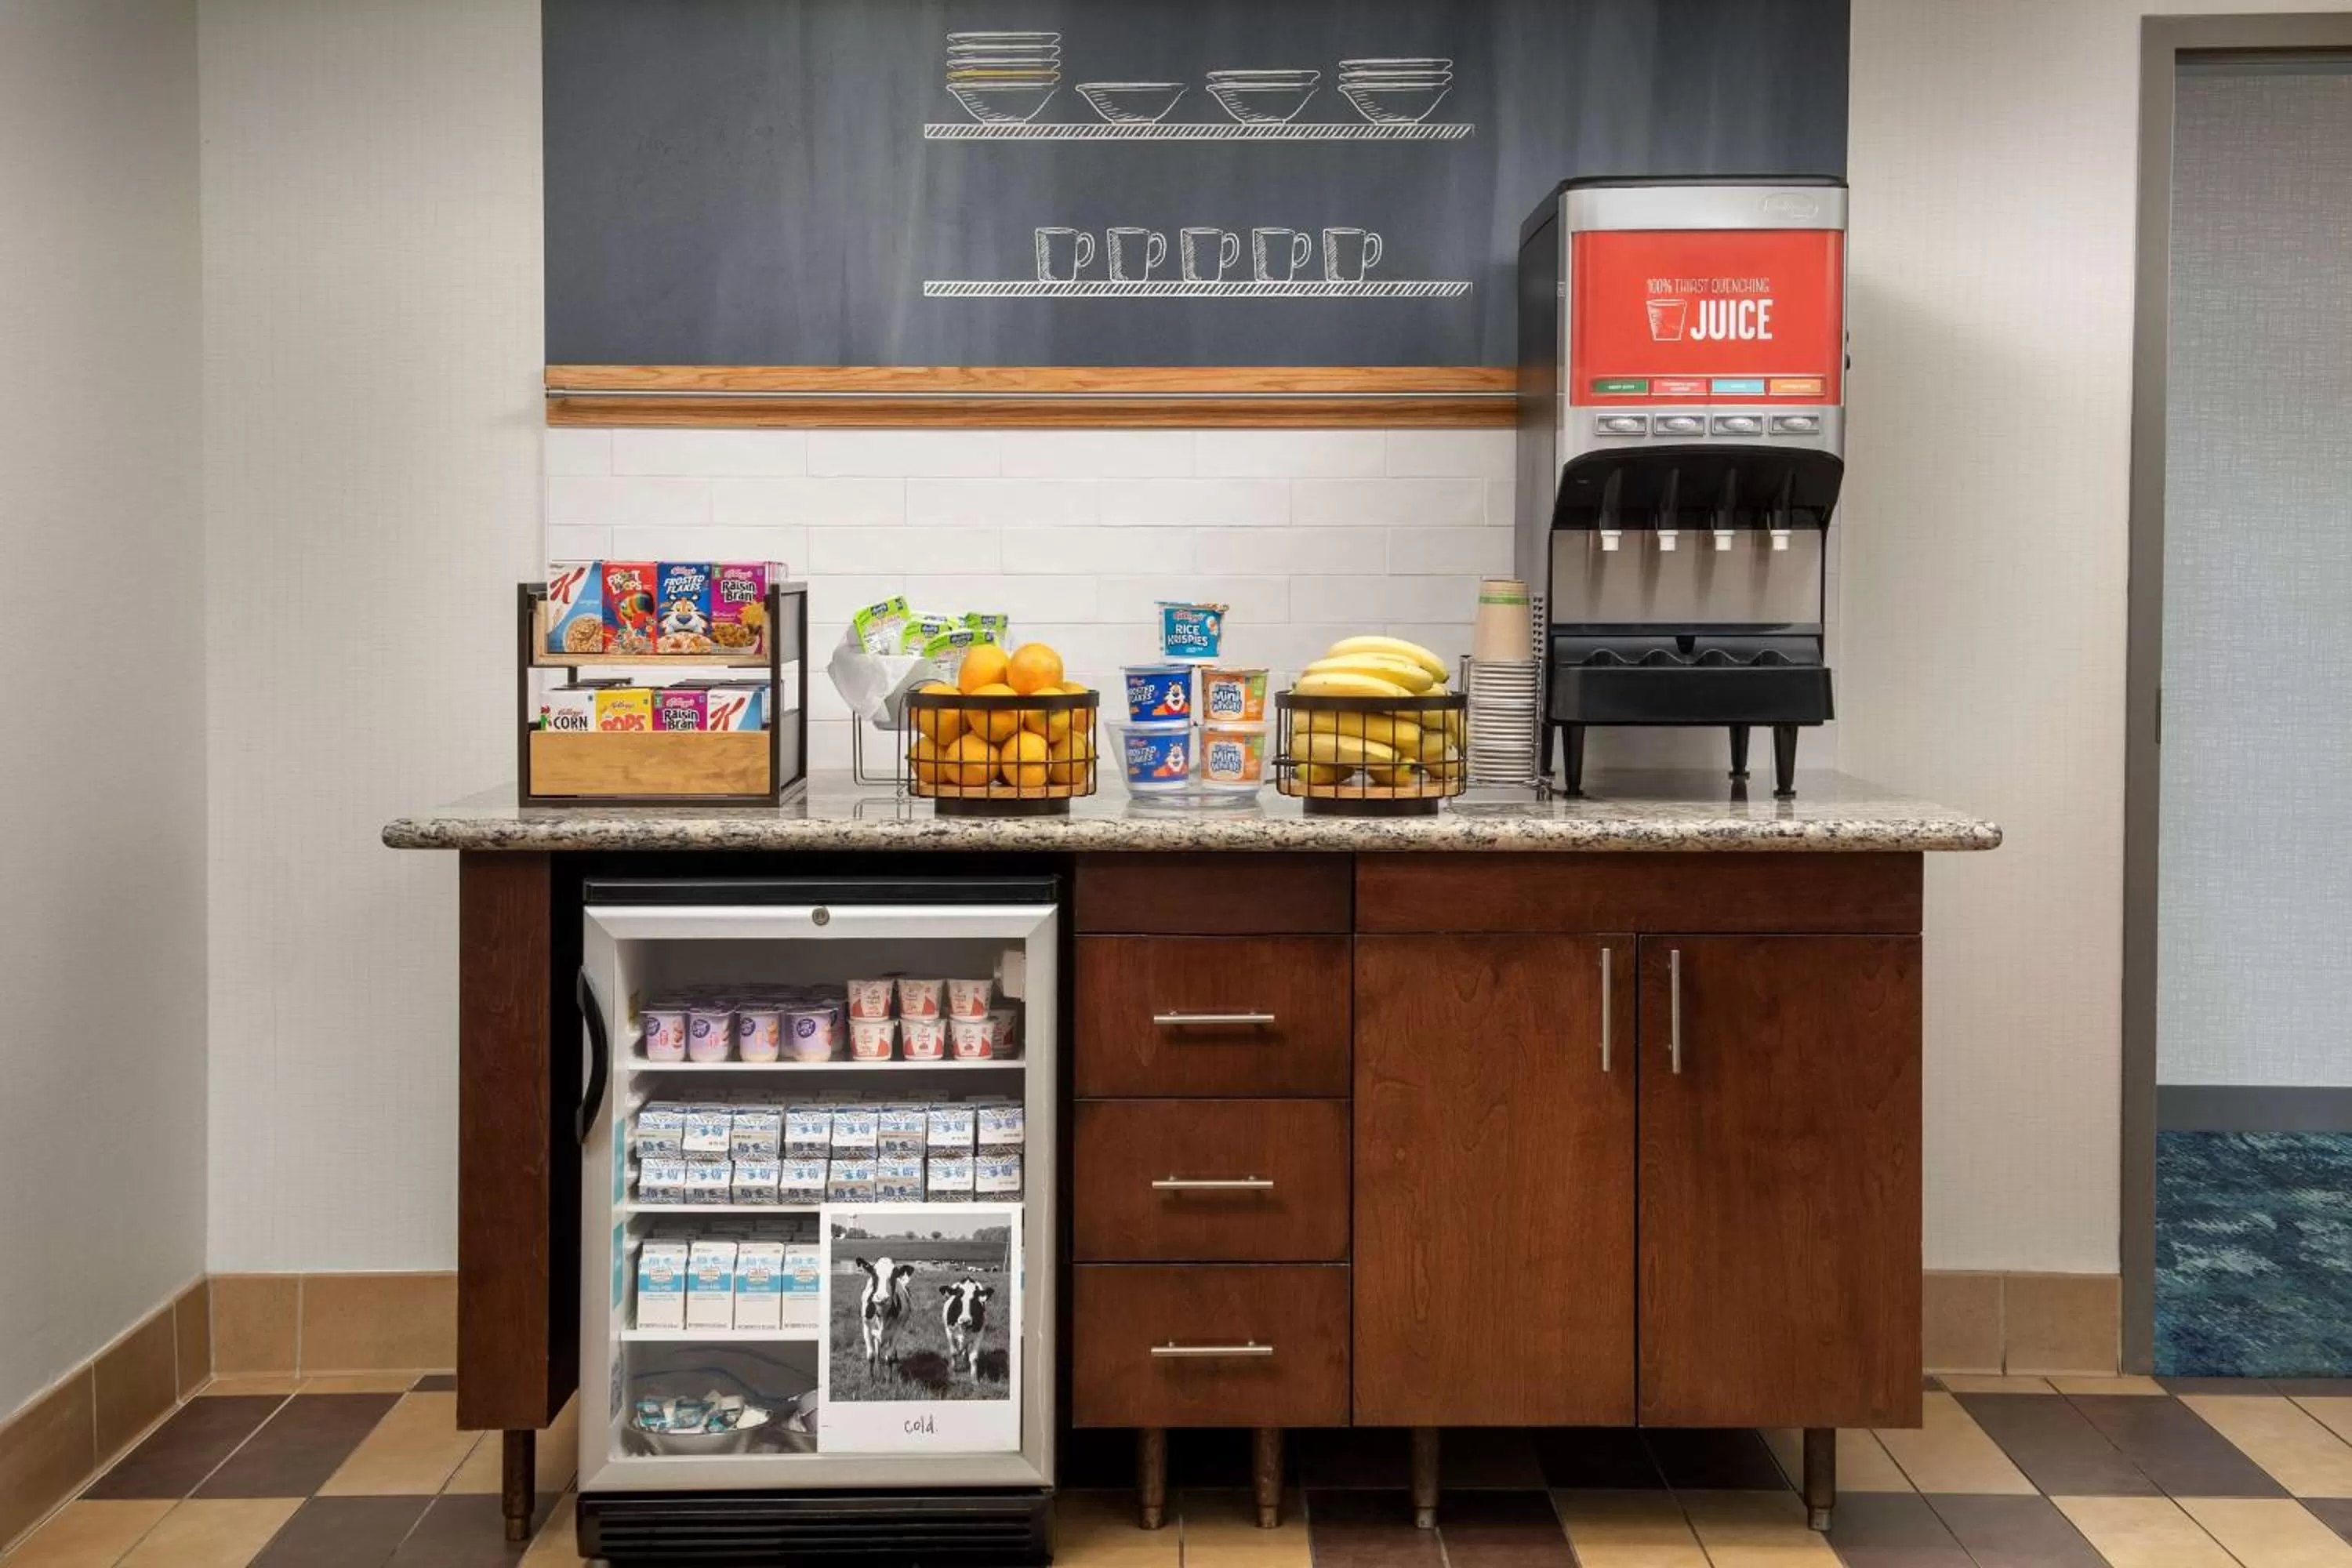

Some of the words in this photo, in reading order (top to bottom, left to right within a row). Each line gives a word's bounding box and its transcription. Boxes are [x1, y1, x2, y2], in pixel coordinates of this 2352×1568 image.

[1647, 278, 1671, 294] 100%
[1675, 278, 1708, 294] THIRST
[1711, 278, 1769, 294] QUENCHING
[1690, 299, 1773, 341] JUICE
[663, 575, 705, 587] FROSTED
[721, 580, 756, 593] Raisin
[724, 592, 753, 603] Bran
[1175, 623, 1200, 635] RICE
[1167, 633, 1208, 647] KRISPIES
[663, 709, 698, 721] Raisin
[553, 716, 588, 731] CORN
[667, 720, 695, 731] Bran
